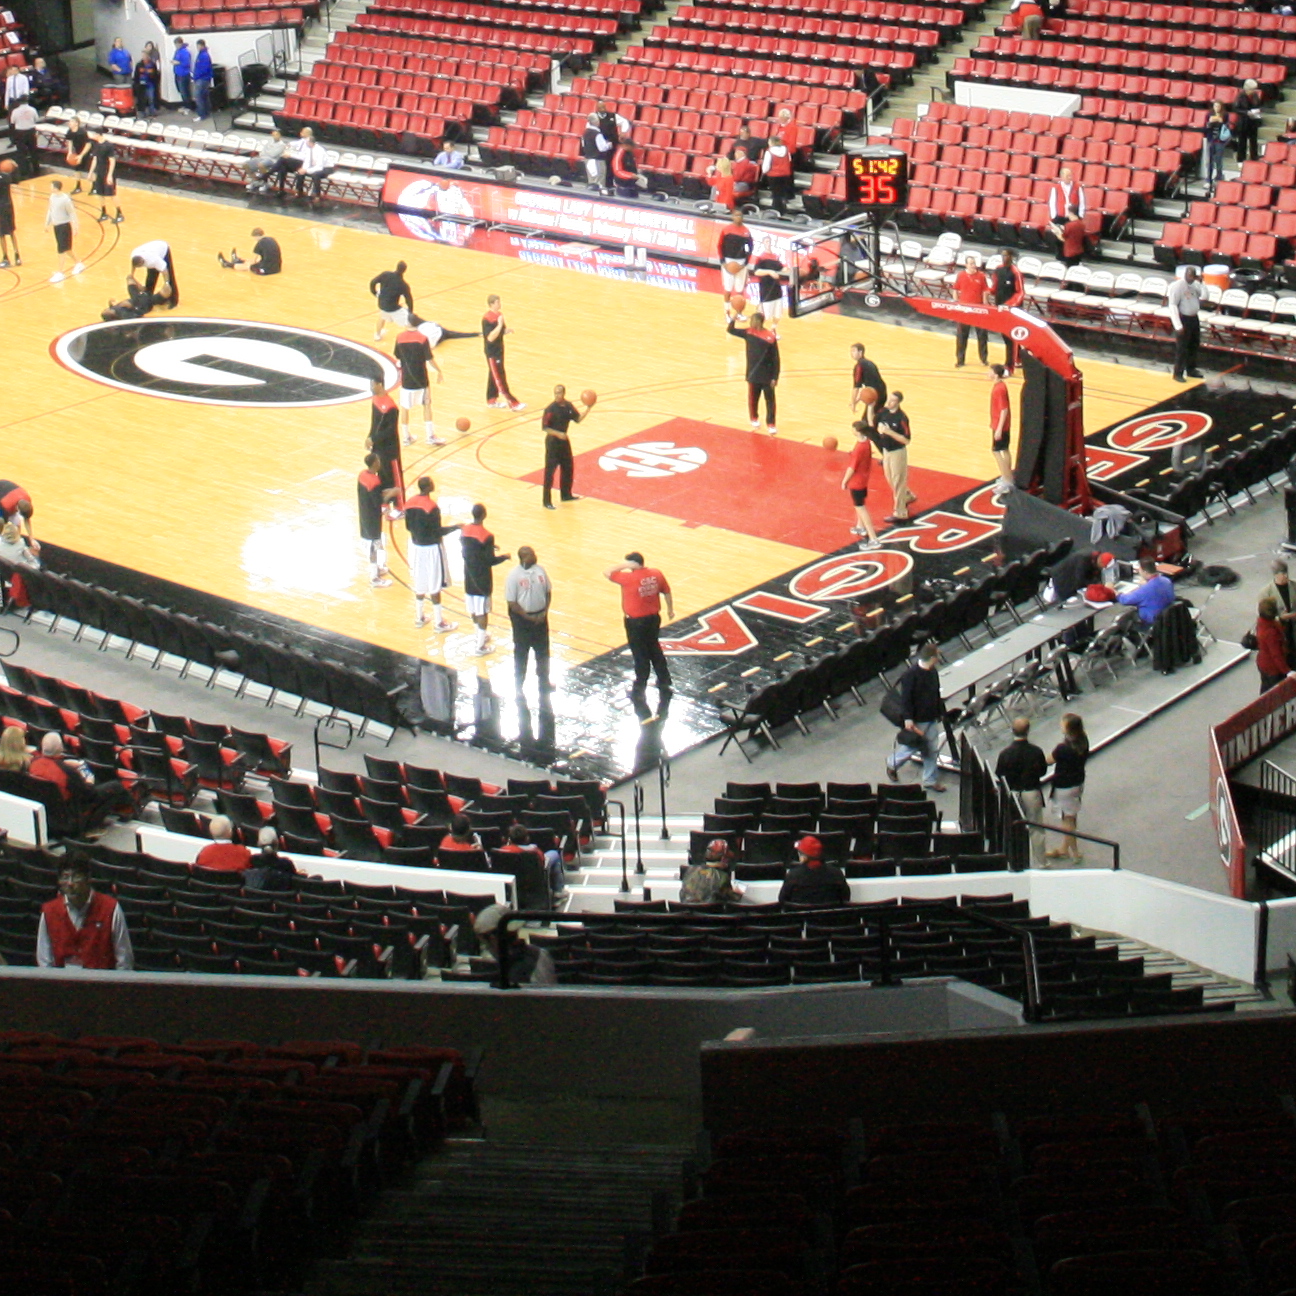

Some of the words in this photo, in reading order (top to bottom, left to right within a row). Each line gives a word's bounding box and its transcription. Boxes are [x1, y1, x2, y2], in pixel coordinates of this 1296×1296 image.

[852, 158, 899, 176] 51:42
[859, 175, 897, 204] 35
[598, 441, 708, 478] SEC
